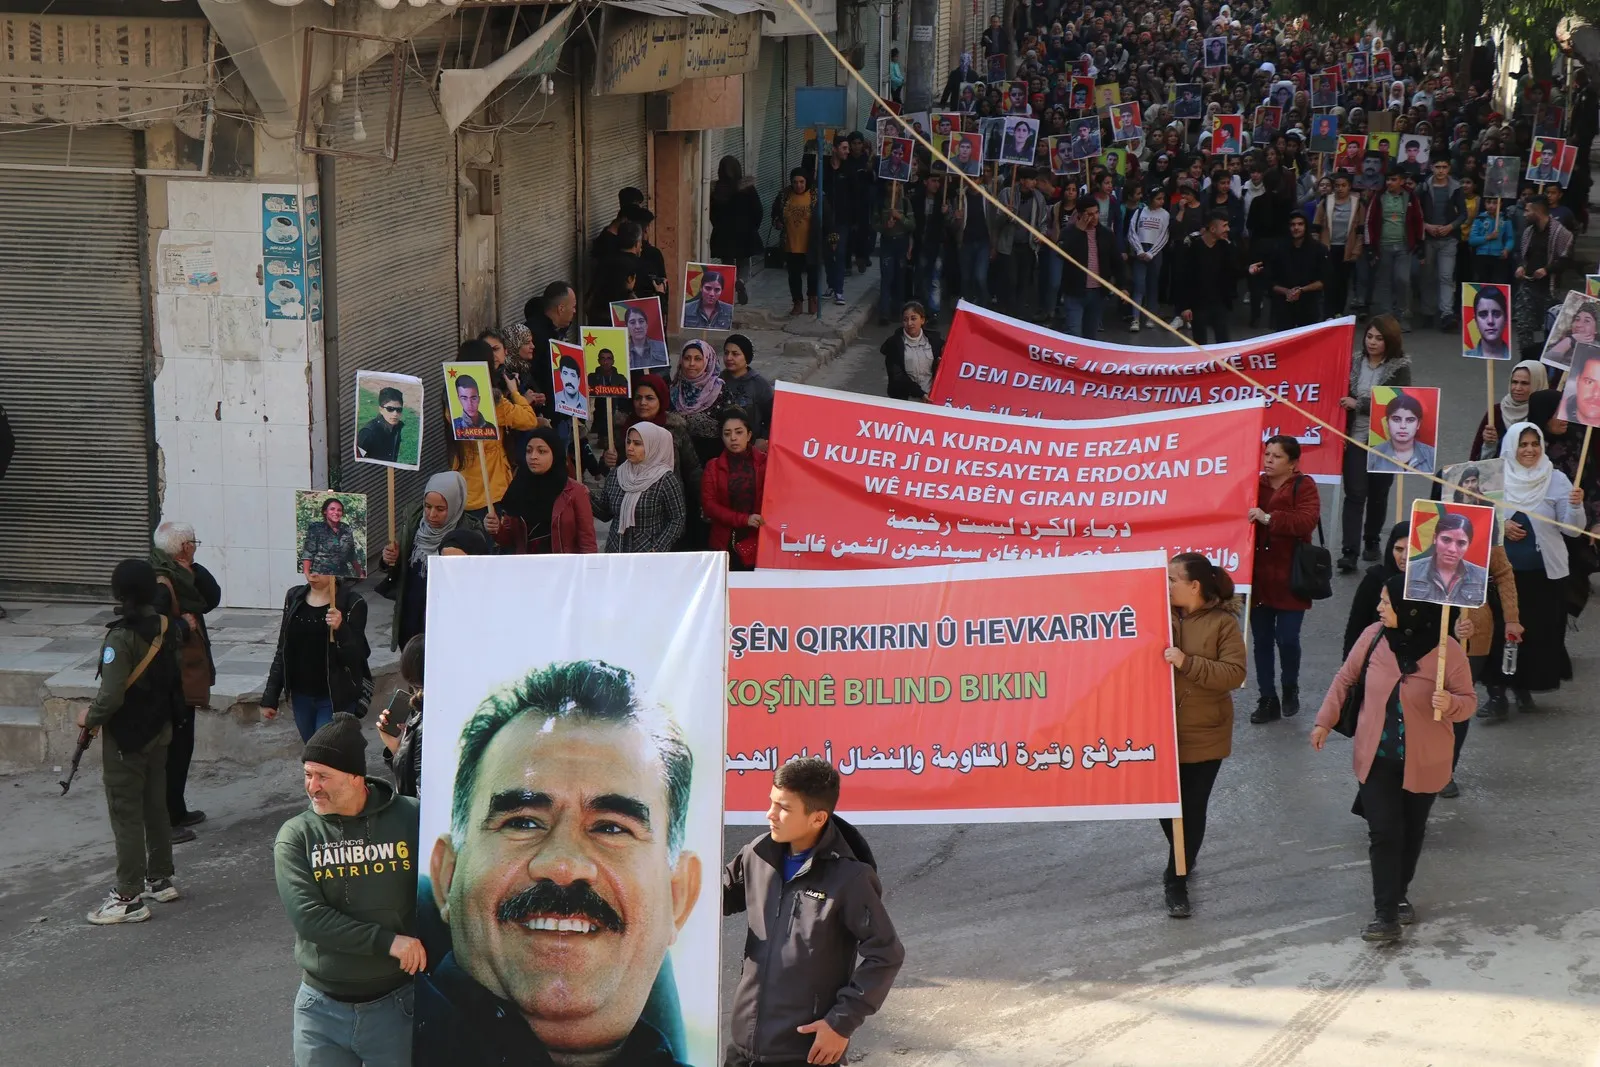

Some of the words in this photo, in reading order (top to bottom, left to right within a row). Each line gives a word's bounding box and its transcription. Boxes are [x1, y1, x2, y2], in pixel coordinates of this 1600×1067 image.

[1029, 344, 1078, 368] BESE
[1080, 360, 1099, 373] JI
[1248, 353, 1277, 369] RE
[959, 362, 1008, 385] DEM
[1012, 371, 1075, 395] DEMA
[1081, 382, 1201, 403] PARASTINA
[1294, 384, 1320, 402] YE
[856, 419, 935, 446] XWÎNA
[942, 432, 1042, 456] KURDAN
[1047, 441, 1079, 457] NE
[1084, 435, 1160, 457] ERZAN
[1166, 432, 1179, 450] E
[803, 440, 819, 459] Û
[824, 445, 896, 468] KUJER
[924, 457, 949, 474] DI
[955, 459, 1070, 482] KESAYETA
[1076, 459, 1190, 483] ERDOXAN
[1196, 456, 1228, 476] DE
[864, 475, 900, 495] WÊ
[904, 480, 1014, 505] HESABÊN
[1019, 490, 1095, 507] GIRAN
[1100, 489, 1167, 507] BIDIN
[886, 509, 951, 536] رخيصة
[956, 517, 1015, 540] ليست
[1020, 517, 1076, 541] الكرد
[1082, 518, 1132, 539] دماء
[831, 536, 889, 558] الثمن
[891, 542, 983, 562] سيدفعون
[730, 620, 789, 659] ŞÊN
[796, 621, 930, 656] QIRKIRIN
[935, 616, 958, 648] Û
[964, 605, 1138, 647] HEVKARIYÊ
[844, 675, 952, 706] BILIND
[959, 671, 1047, 702] BIKIN
[838, 745, 926, 776] والنضال
[930, 741, 1008, 773] المقاومة
[1014, 741, 1075, 770] وتيرة
[1081, 737, 1156, 769] سنرفع
[311, 843, 395, 868] RAINBOW
[396, 841, 409, 859] 6
[313, 860, 411, 882] PATRIOTS
